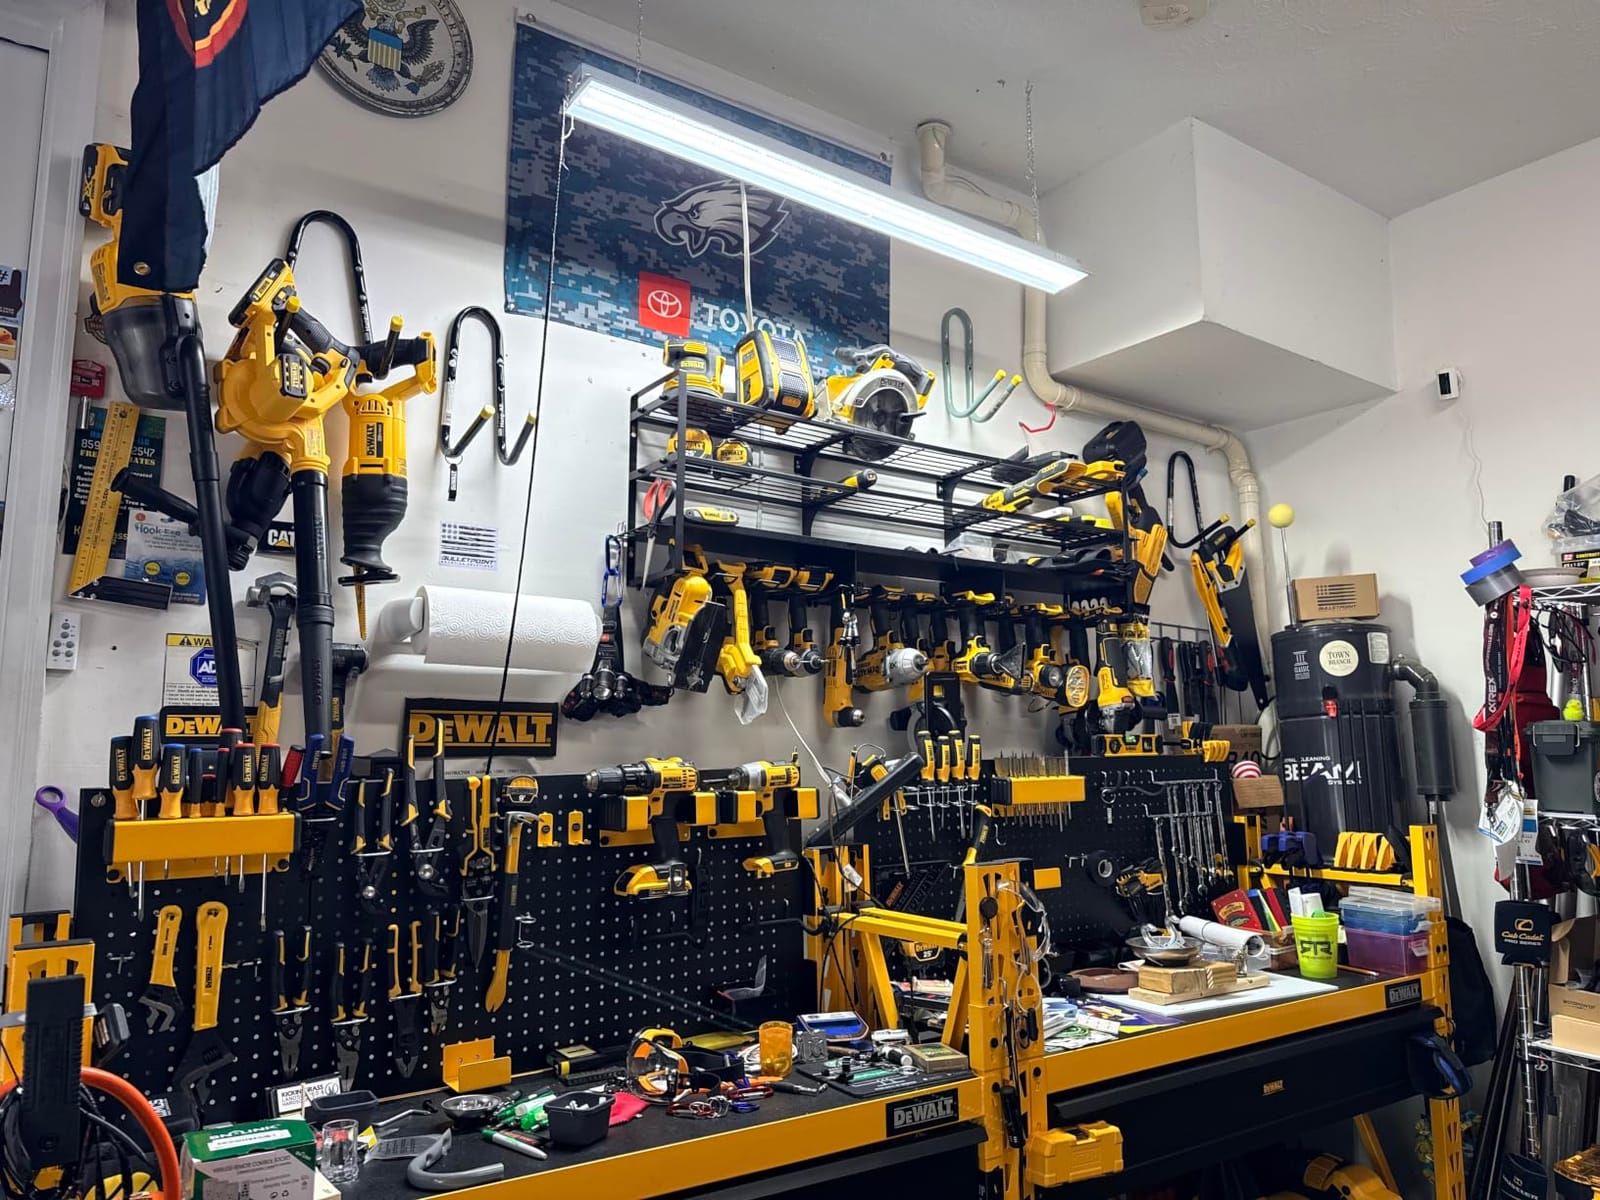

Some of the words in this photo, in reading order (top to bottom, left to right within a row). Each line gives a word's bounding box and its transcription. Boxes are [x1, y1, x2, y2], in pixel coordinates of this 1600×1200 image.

[268, 529, 296, 547] CAT
[1327, 650, 1351, 660] TOWN
[409, 713, 553, 744] DEWALT
[142, 728, 153, 761] DEWALT
[116, 748, 127, 781] DEWALT
[171, 755, 181, 785] DEWALT
[242, 754, 252, 782] DEWALT
[260, 753, 270, 781] DEWALT
[1388, 985, 1420, 1004] DEWALT
[894, 1098, 954, 1129] DEWALT
